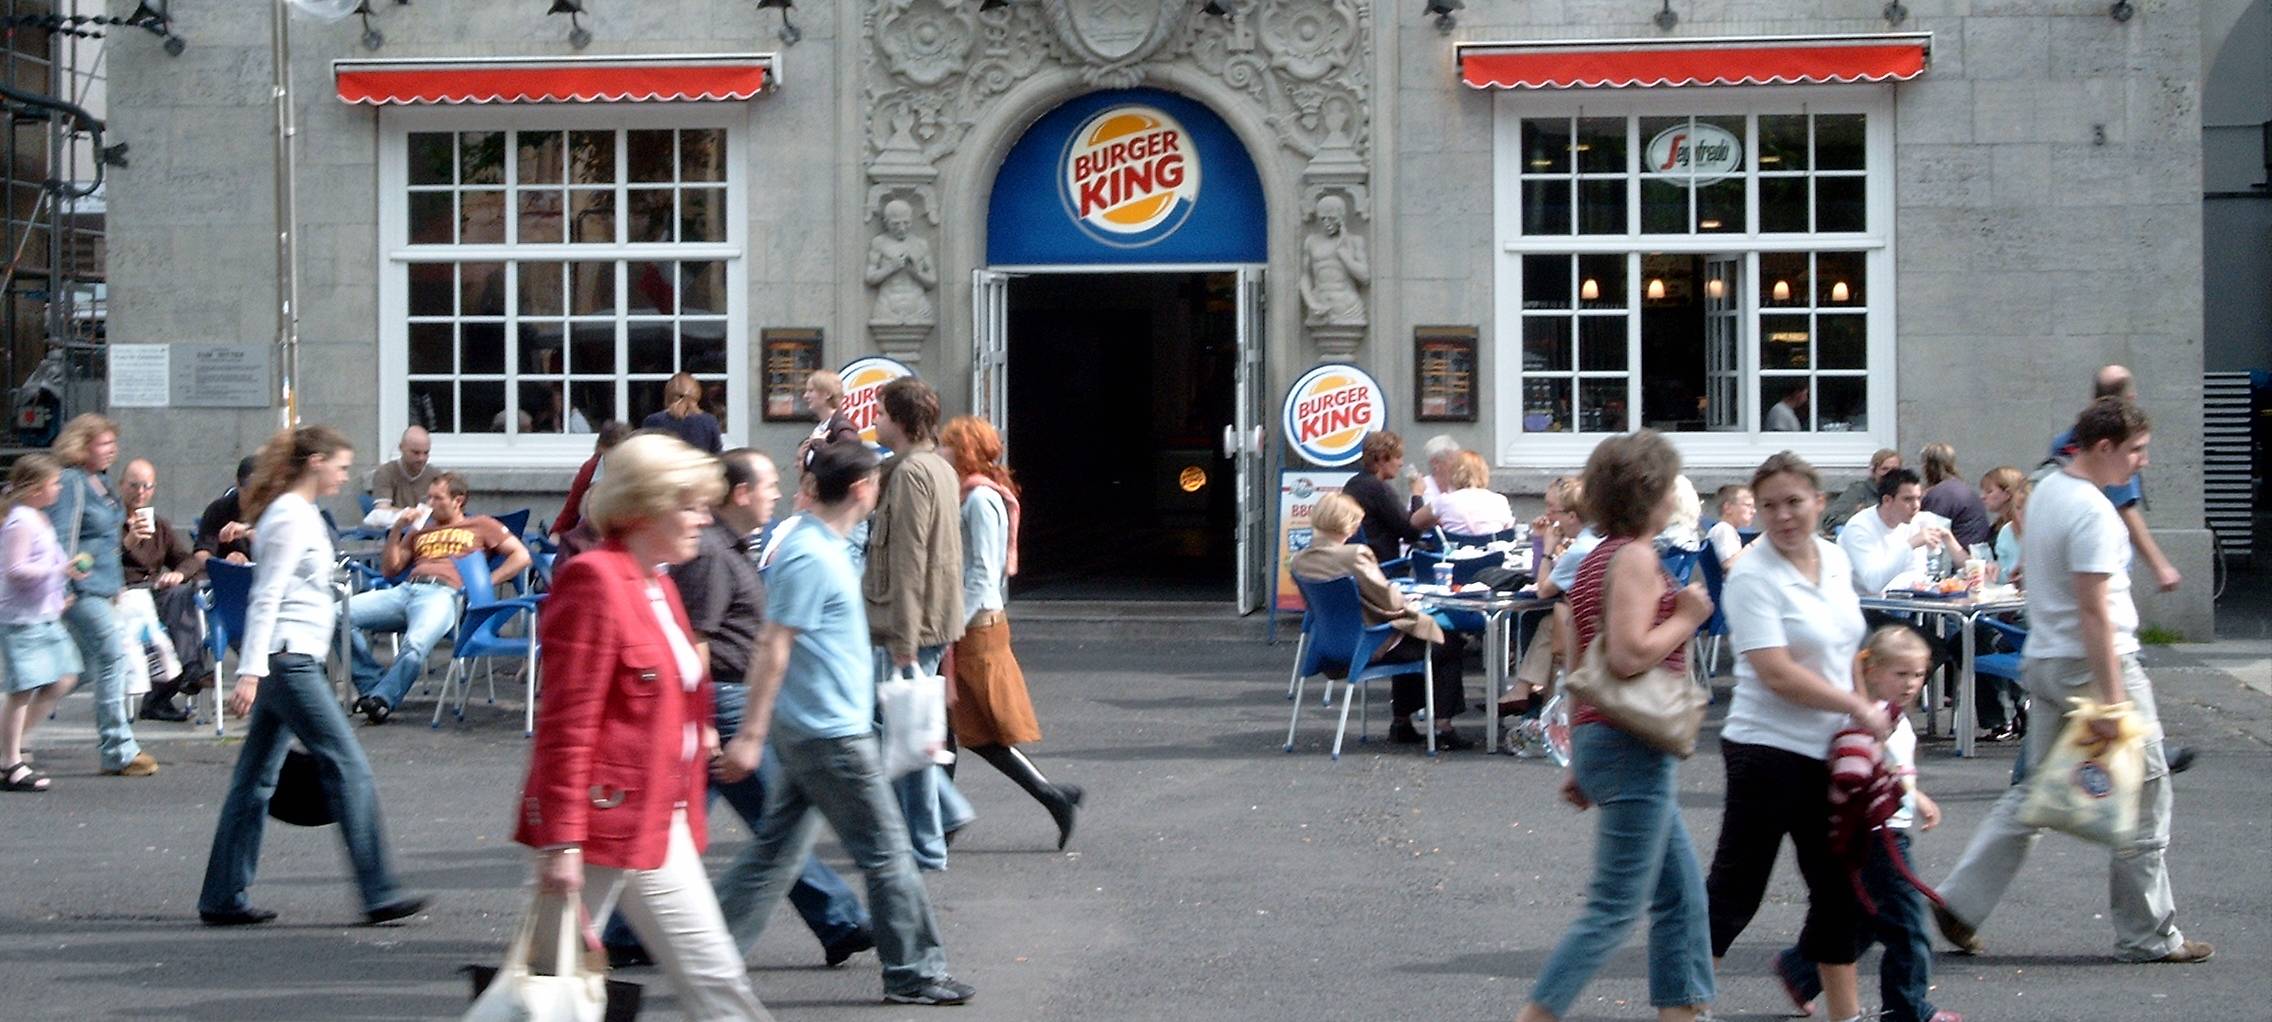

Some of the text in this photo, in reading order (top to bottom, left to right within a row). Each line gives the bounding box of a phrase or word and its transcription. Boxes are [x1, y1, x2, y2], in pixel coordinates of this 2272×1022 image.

[1075, 130, 1179, 183] BURGER
[1080, 154, 1184, 218] KING
[841, 384, 886, 412] BURG
[1298, 386, 1369, 420] BURGER
[1301, 402, 1371, 443] KING
